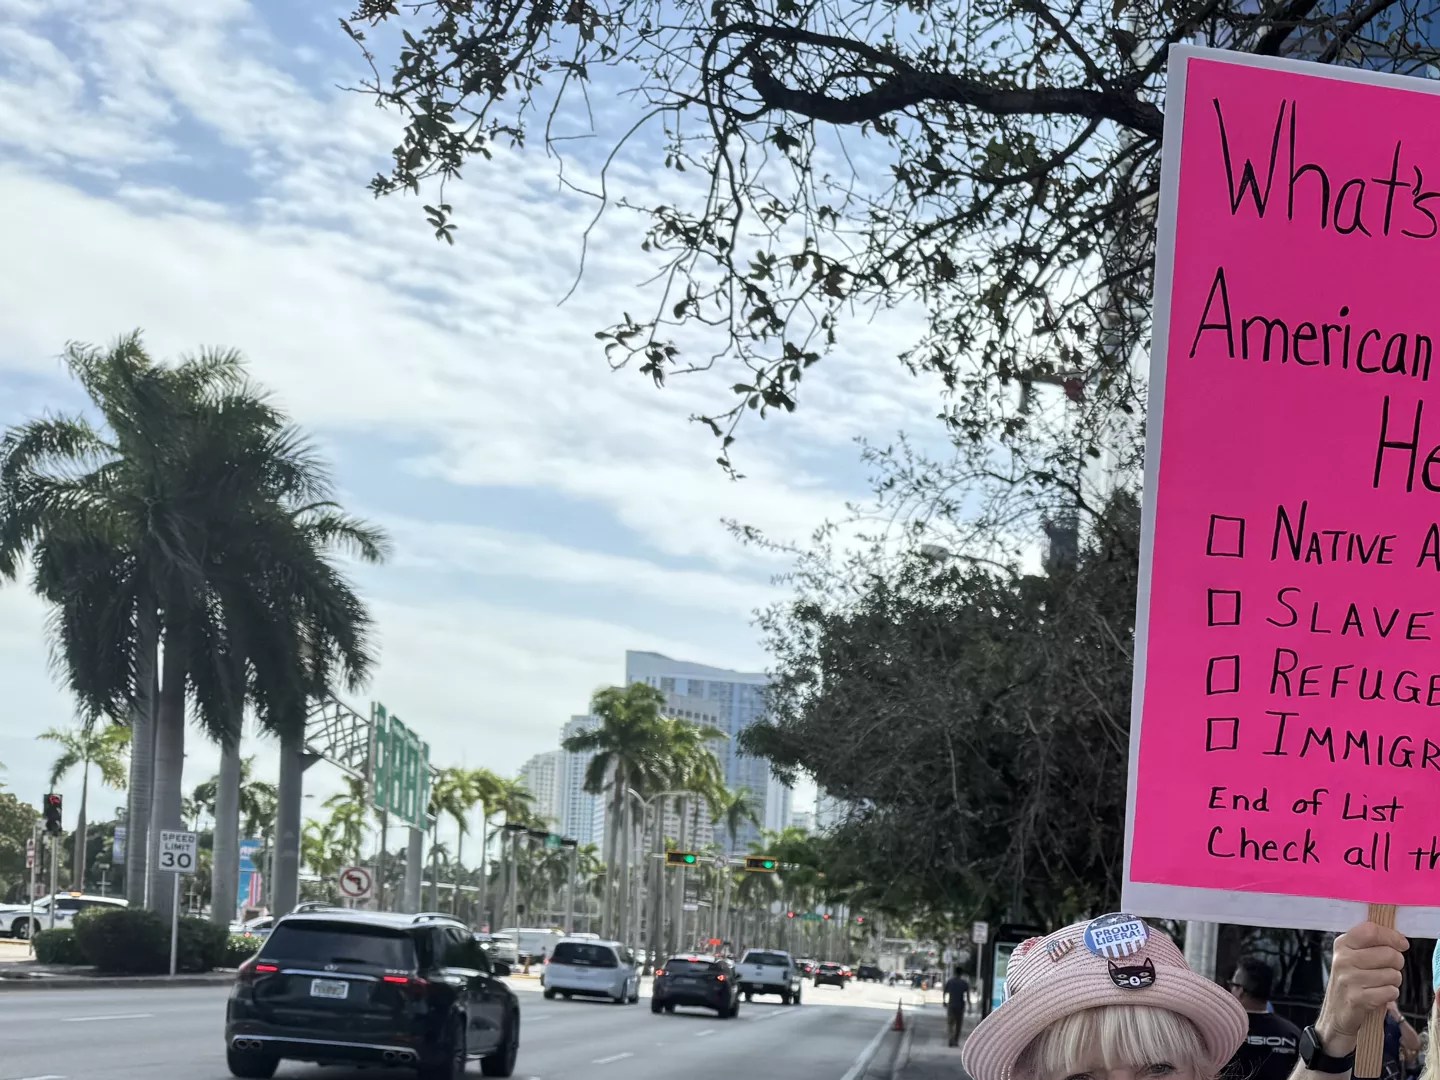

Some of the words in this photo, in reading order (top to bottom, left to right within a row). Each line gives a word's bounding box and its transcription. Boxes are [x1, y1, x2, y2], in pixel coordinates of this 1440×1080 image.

[1189, 266, 1432, 382] American
[1271, 501, 1397, 566] NATIVE
[1266, 587, 1434, 641] SLAVE
[1208, 786, 1269, 813] End
[1292, 788, 1328, 815] of
[1342, 794, 1404, 823] List
[162, 833, 194, 843] SPEED
[1207, 828, 1320, 865] Check
[1344, 832, 1390, 872] all
[162, 852, 191, 868] 30
[1095, 923, 1139, 938] PROUD
[1095, 929, 1145, 945] LIBERAL
[1247, 1036, 1297, 1046] ISION
